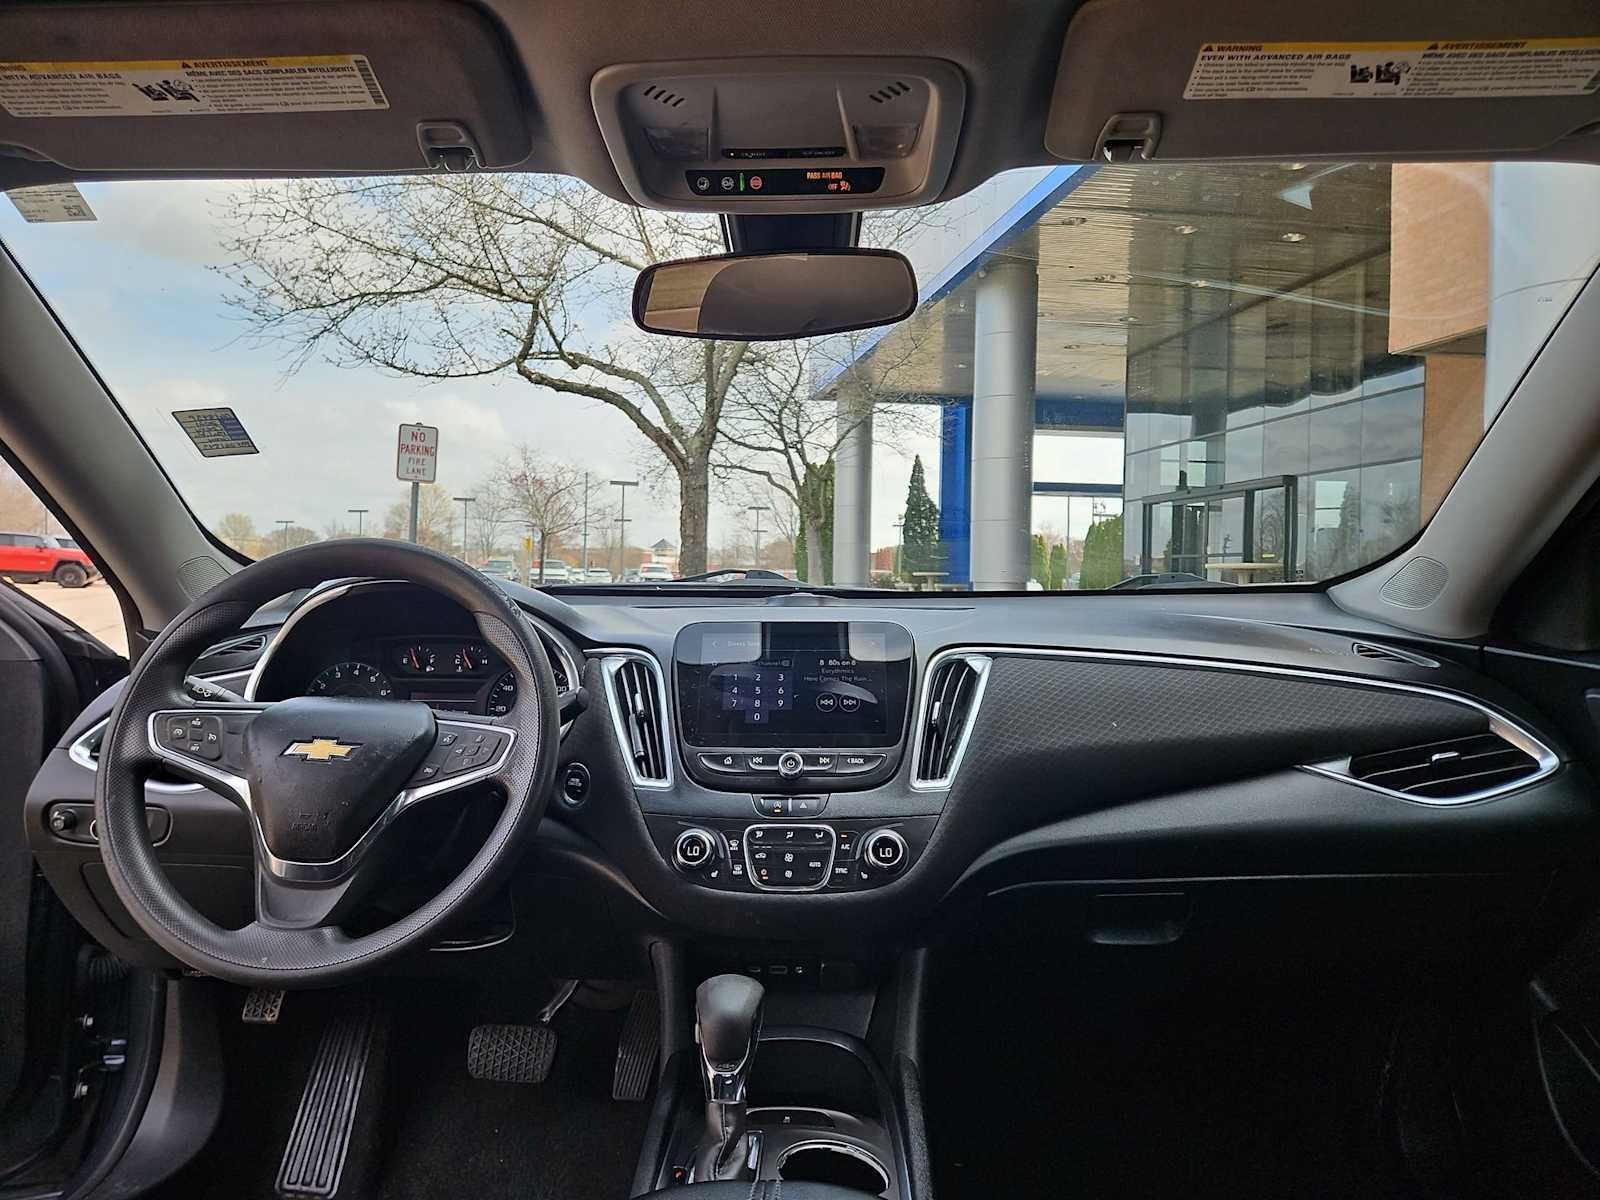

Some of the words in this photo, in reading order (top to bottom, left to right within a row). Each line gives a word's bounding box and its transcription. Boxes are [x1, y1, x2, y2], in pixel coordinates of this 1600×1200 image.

[806, 171, 821, 179] PASS
[411, 431, 426, 442] NO
[400, 443, 435, 457] PARKING
[408, 457, 426, 466] FIRE
[406, 466, 426, 476] LANE
[755, 673, 761, 681] 2
[778, 673, 784, 681] 3
[502, 684, 513, 692] 40
[755, 686, 761, 695] 5
[778, 686, 784, 694] 6
[754, 699, 760, 707] 8
[778, 699, 784, 707] 9
[495, 704, 506, 712] 20
[754, 712, 760, 720] 0
[686, 845, 701, 857] LO
[840, 843, 851, 851] A/C
[879, 847, 893, 858] LO
